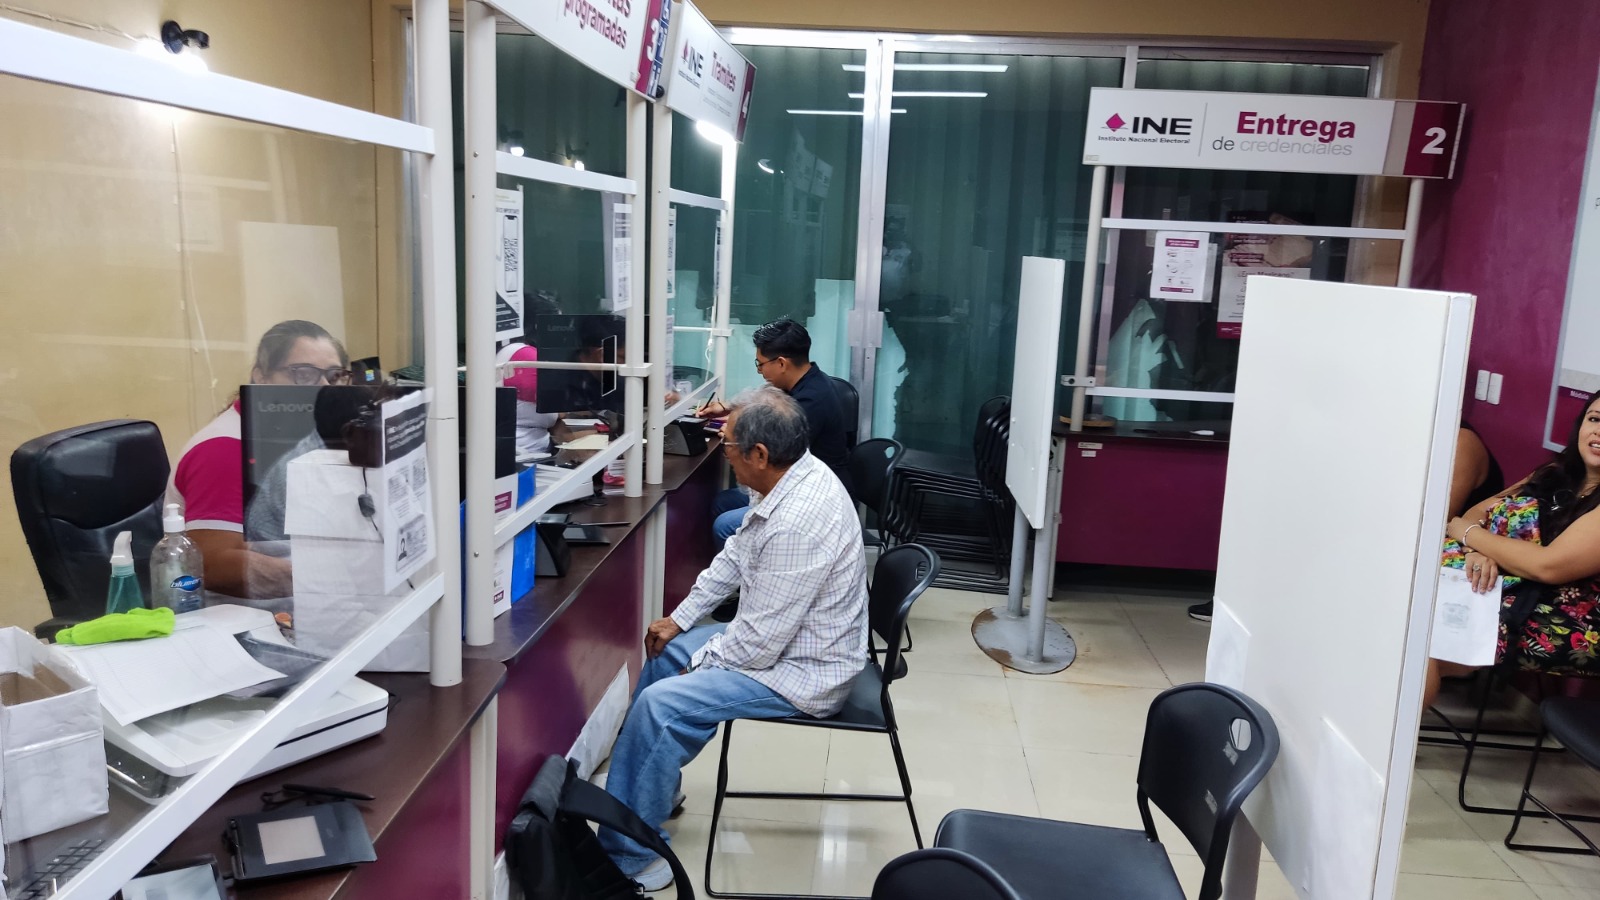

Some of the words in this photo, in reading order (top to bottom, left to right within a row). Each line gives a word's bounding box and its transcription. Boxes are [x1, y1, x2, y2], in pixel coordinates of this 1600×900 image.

[647, 19, 660, 61] 3
[688, 46, 704, 79] INE
[1132, 117, 1193, 136] INE
[1236, 111, 1356, 143] Entrega
[1421, 126, 1447, 155] 2
[1212, 136, 1235, 151] de
[1239, 138, 1353, 156] credenciales
[257, 401, 315, 413] Lenovo
